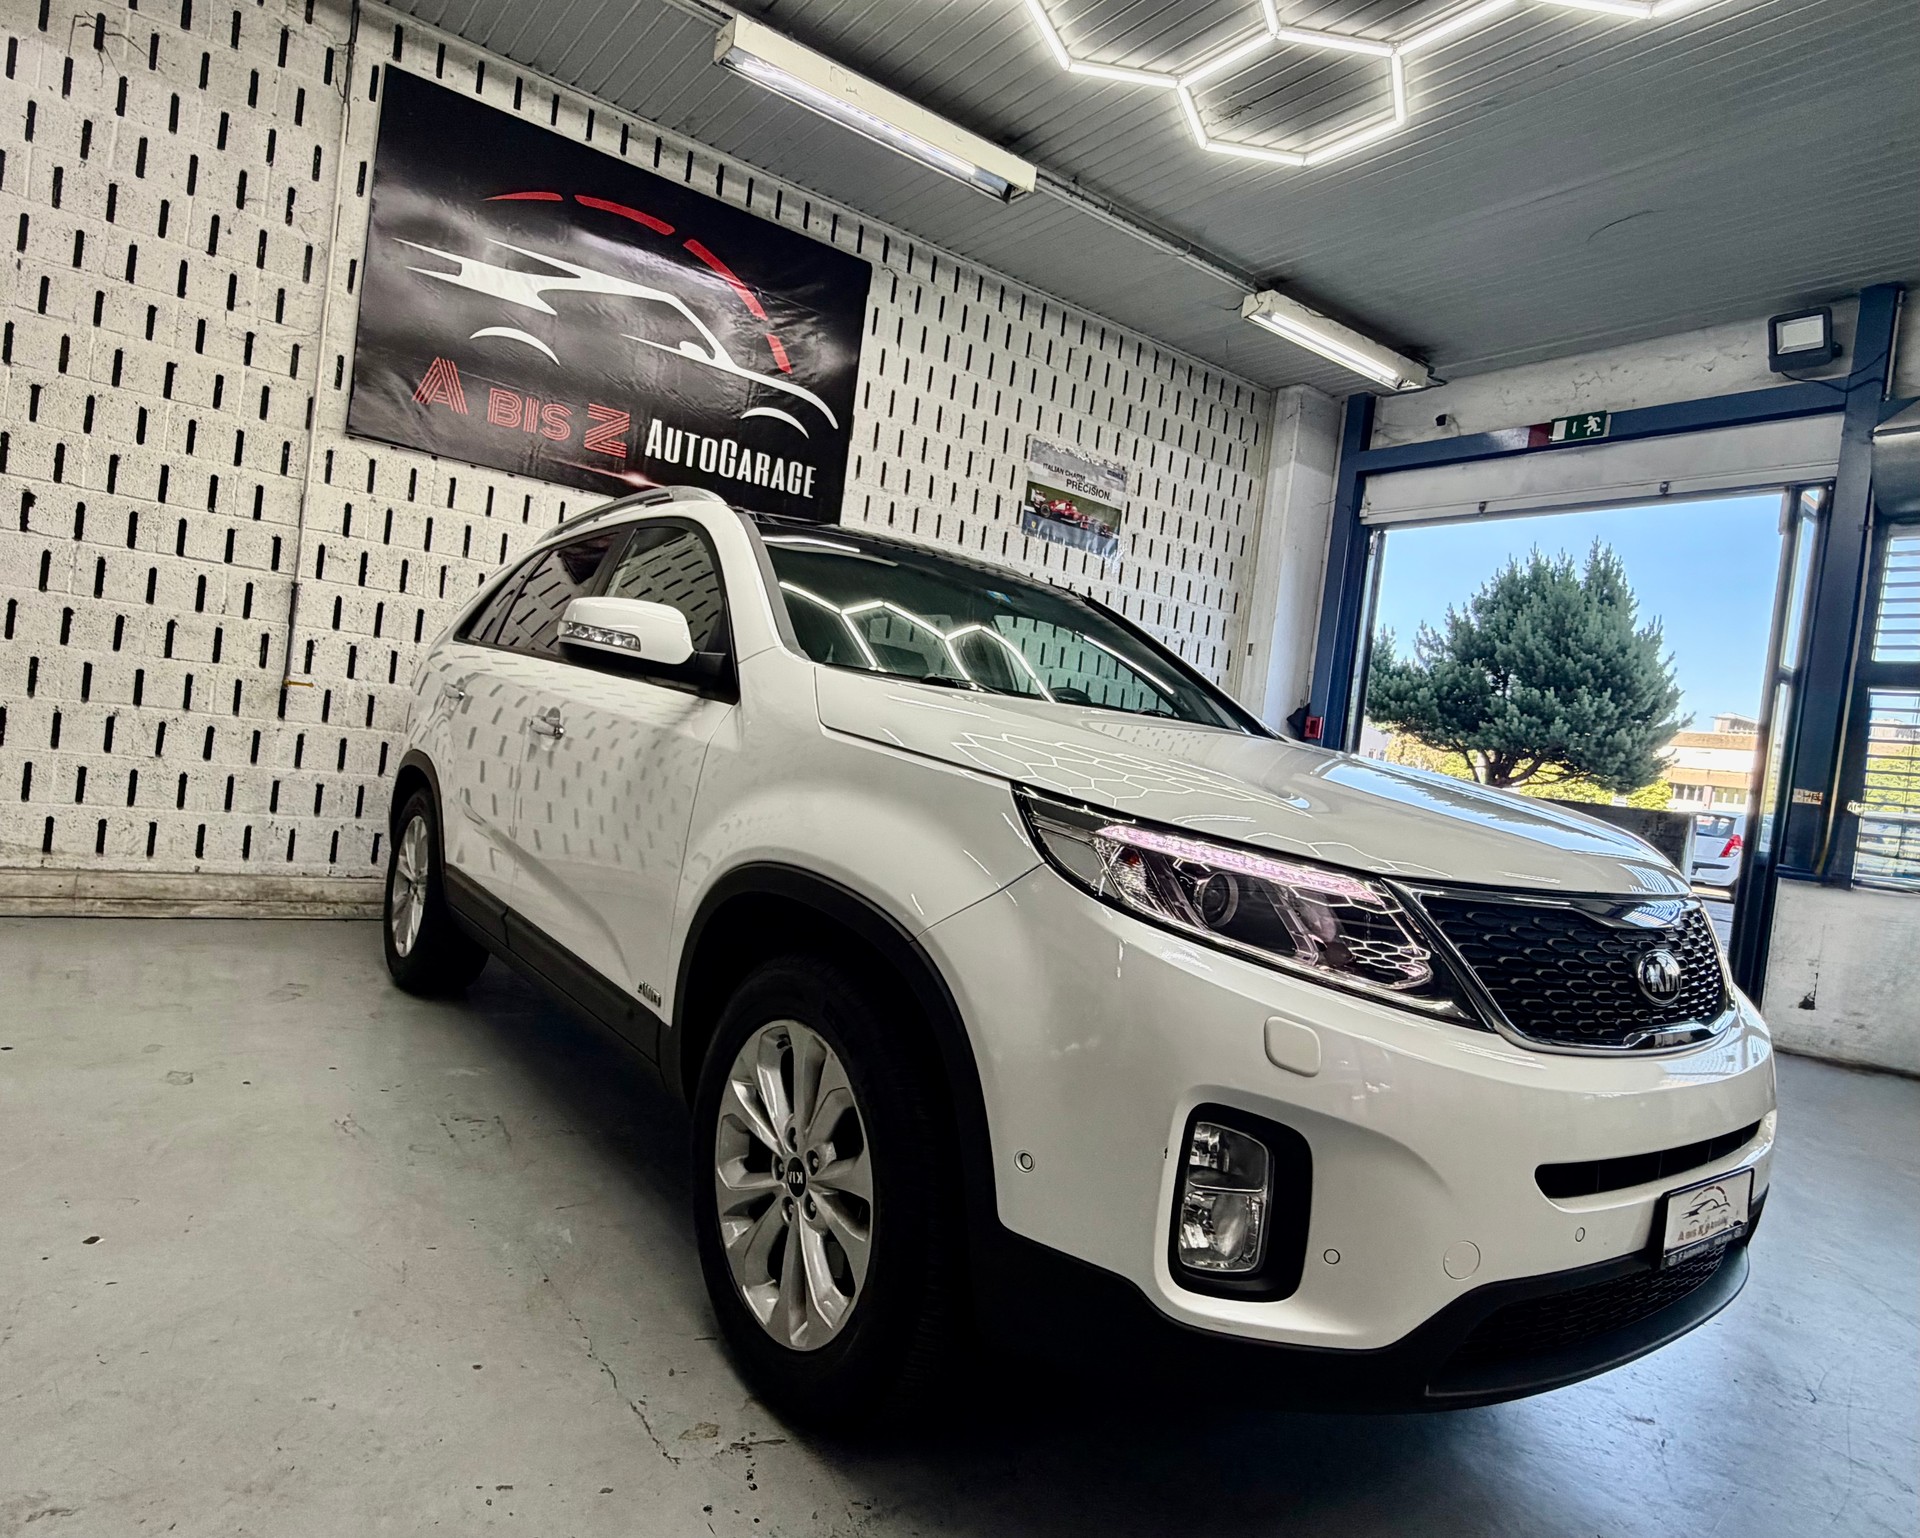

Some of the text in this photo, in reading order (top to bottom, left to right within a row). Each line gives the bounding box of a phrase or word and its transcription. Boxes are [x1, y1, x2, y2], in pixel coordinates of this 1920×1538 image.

[412, 356, 468, 414] A
[487, 387, 572, 441] BIS
[583, 402, 631, 459] Z
[1043, 462, 1064, 475] ITALIAN
[1066, 478, 1111, 501] PRECISION.
